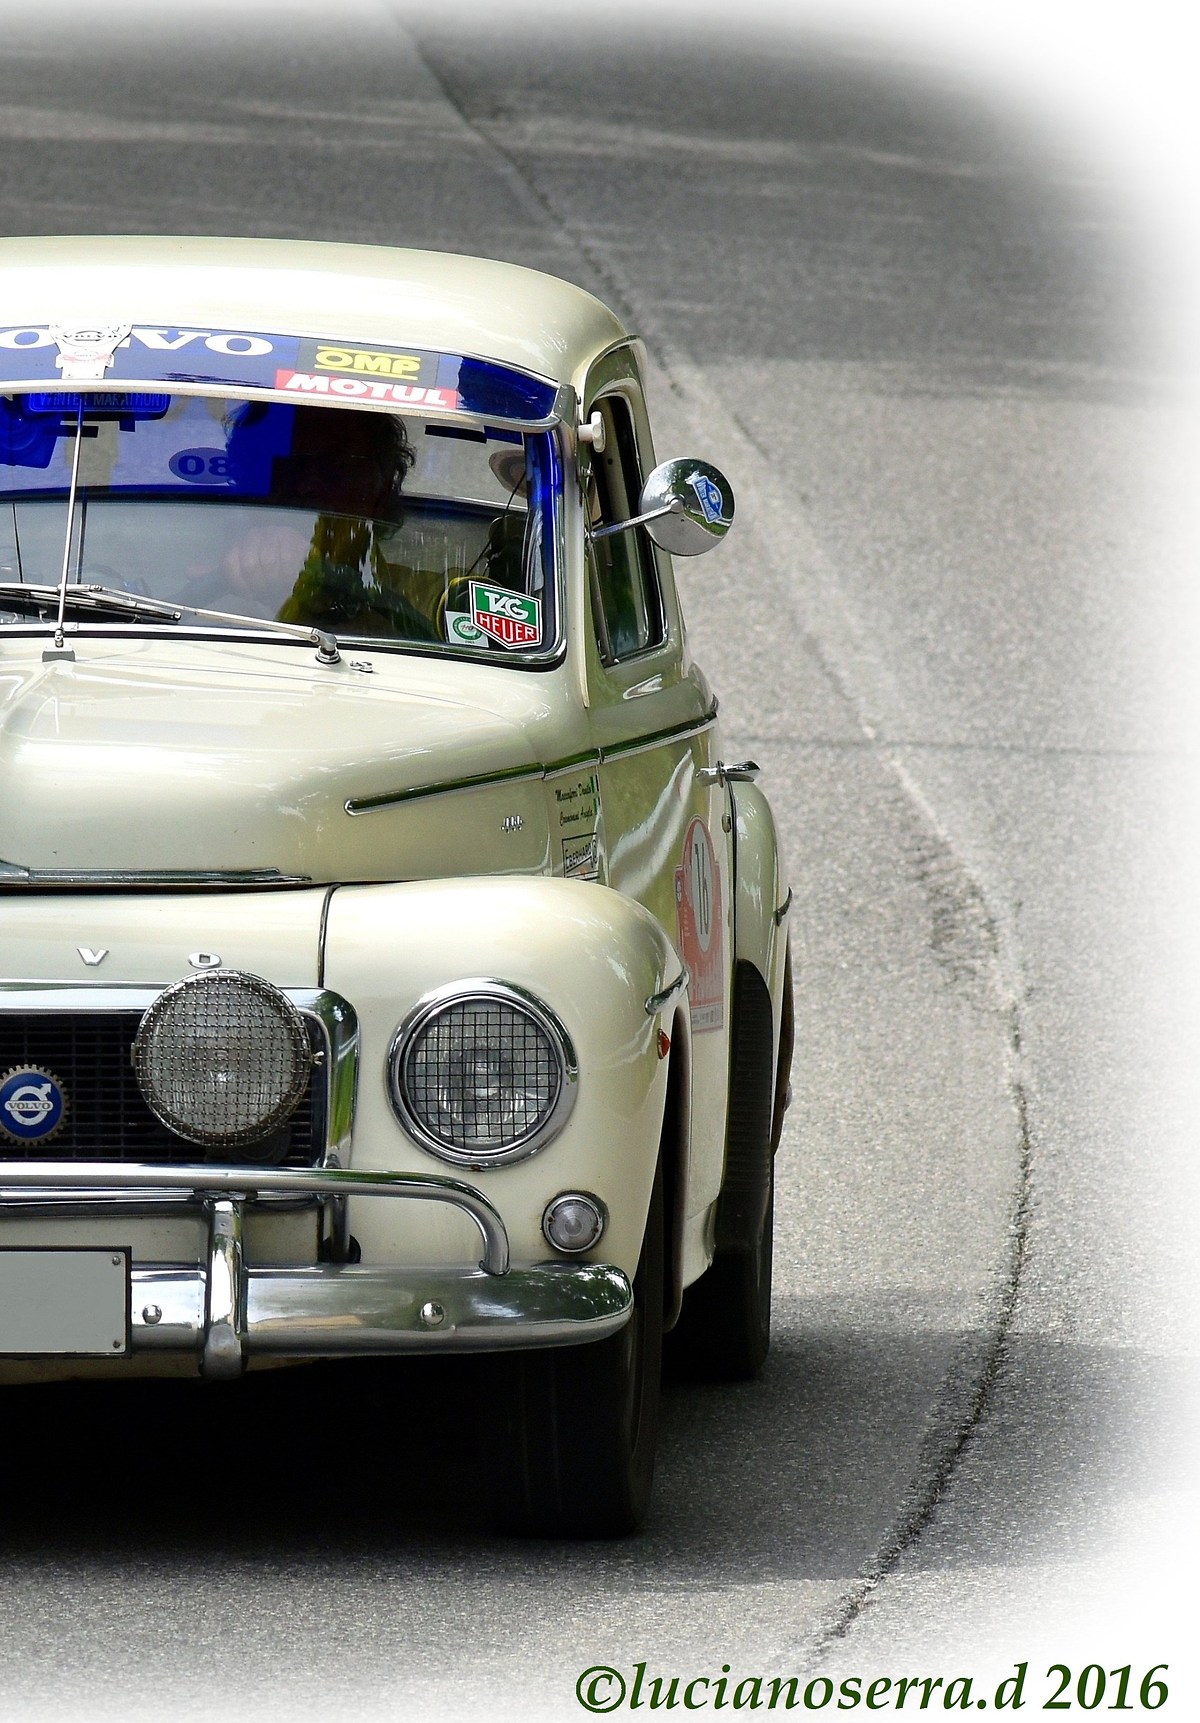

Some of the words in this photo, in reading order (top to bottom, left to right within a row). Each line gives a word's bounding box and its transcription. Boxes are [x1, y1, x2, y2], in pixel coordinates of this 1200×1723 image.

[315, 350, 421, 375] OMP
[285, 373, 448, 406] MOTUL
[484, 591, 529, 620] TAG
[479, 612, 535, 642] HEUER
[7, 1101, 52, 1110] VOLVO
